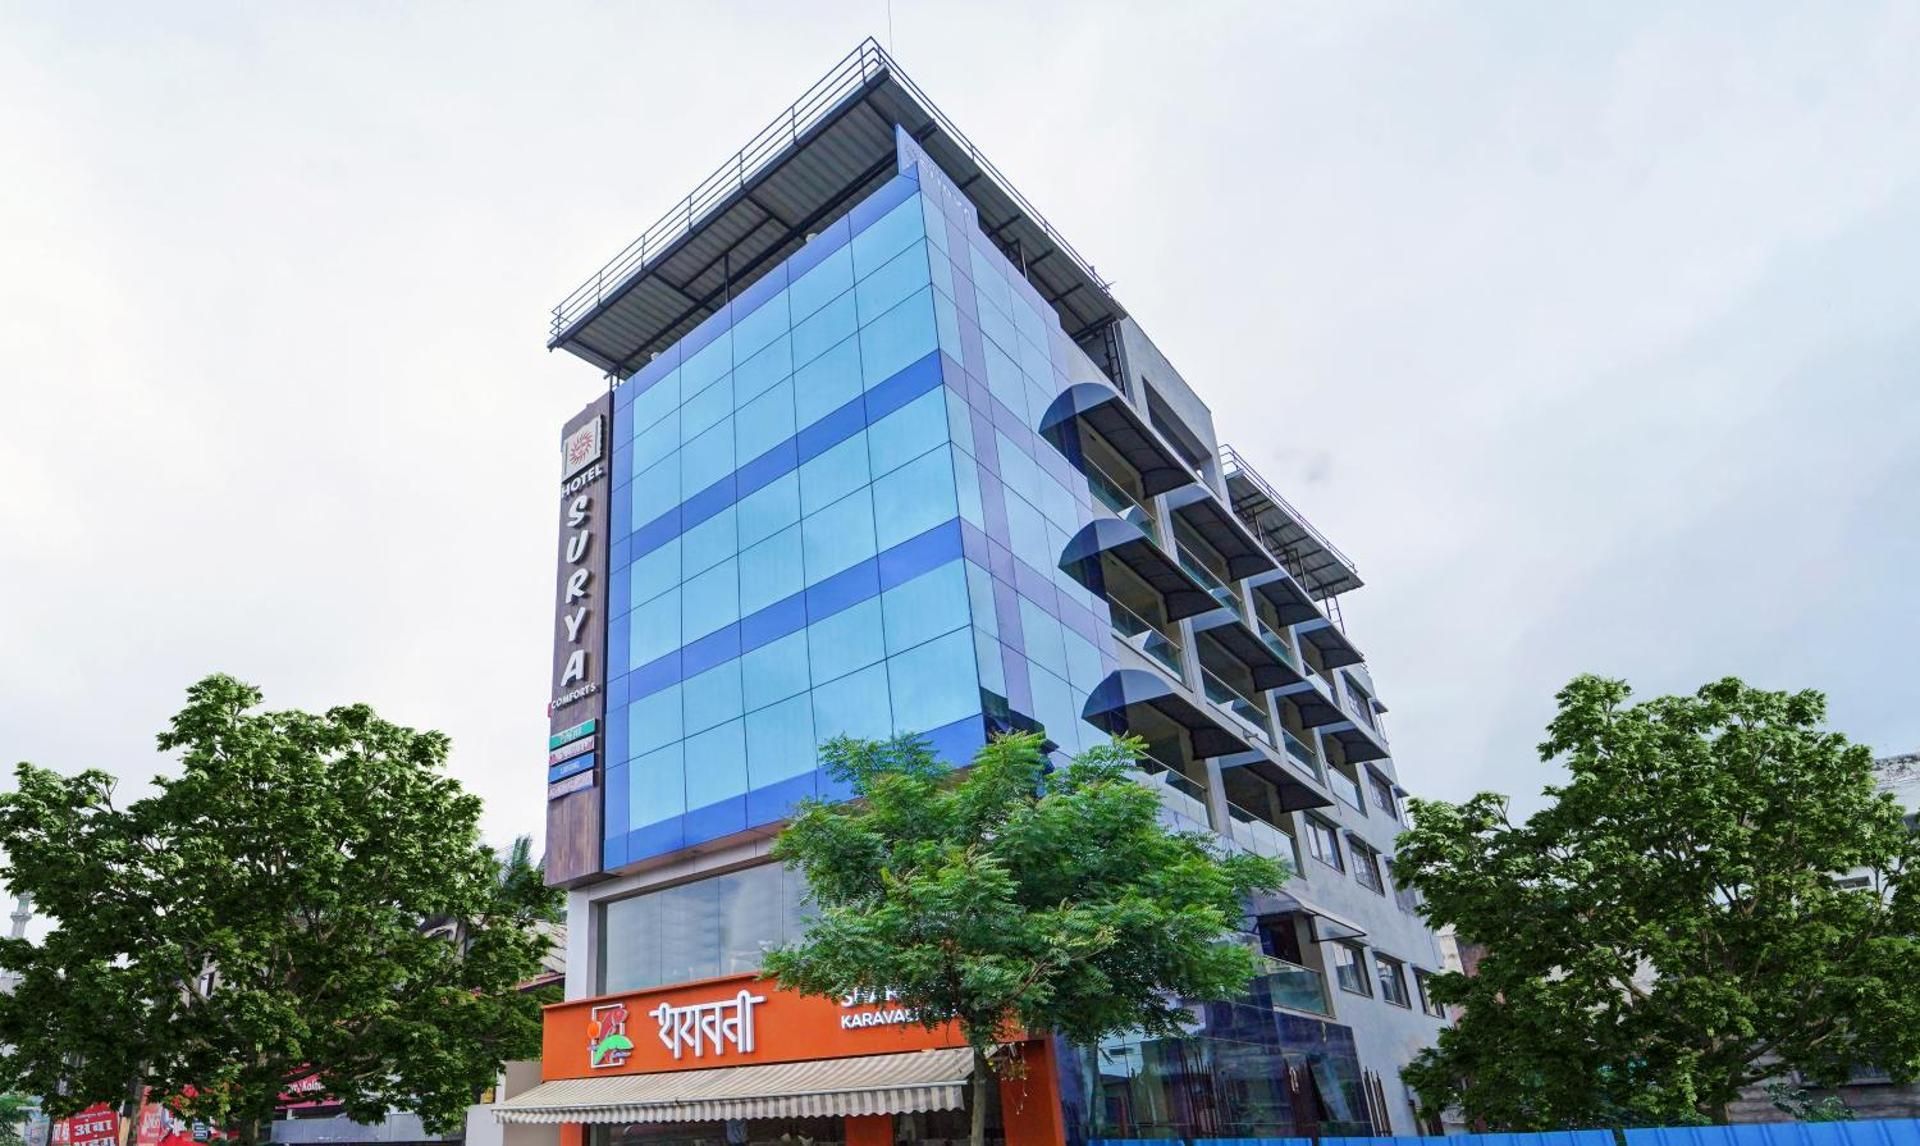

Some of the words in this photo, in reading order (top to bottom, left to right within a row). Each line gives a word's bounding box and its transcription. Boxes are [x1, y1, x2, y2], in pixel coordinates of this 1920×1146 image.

[561, 464, 603, 499] HOTEL
[560, 494, 590, 688] SURYA
[551, 682, 597, 710] COMFORTS
[648, 989, 767, 1060] शरावती
[841, 1006, 920, 1029] KARAVA
